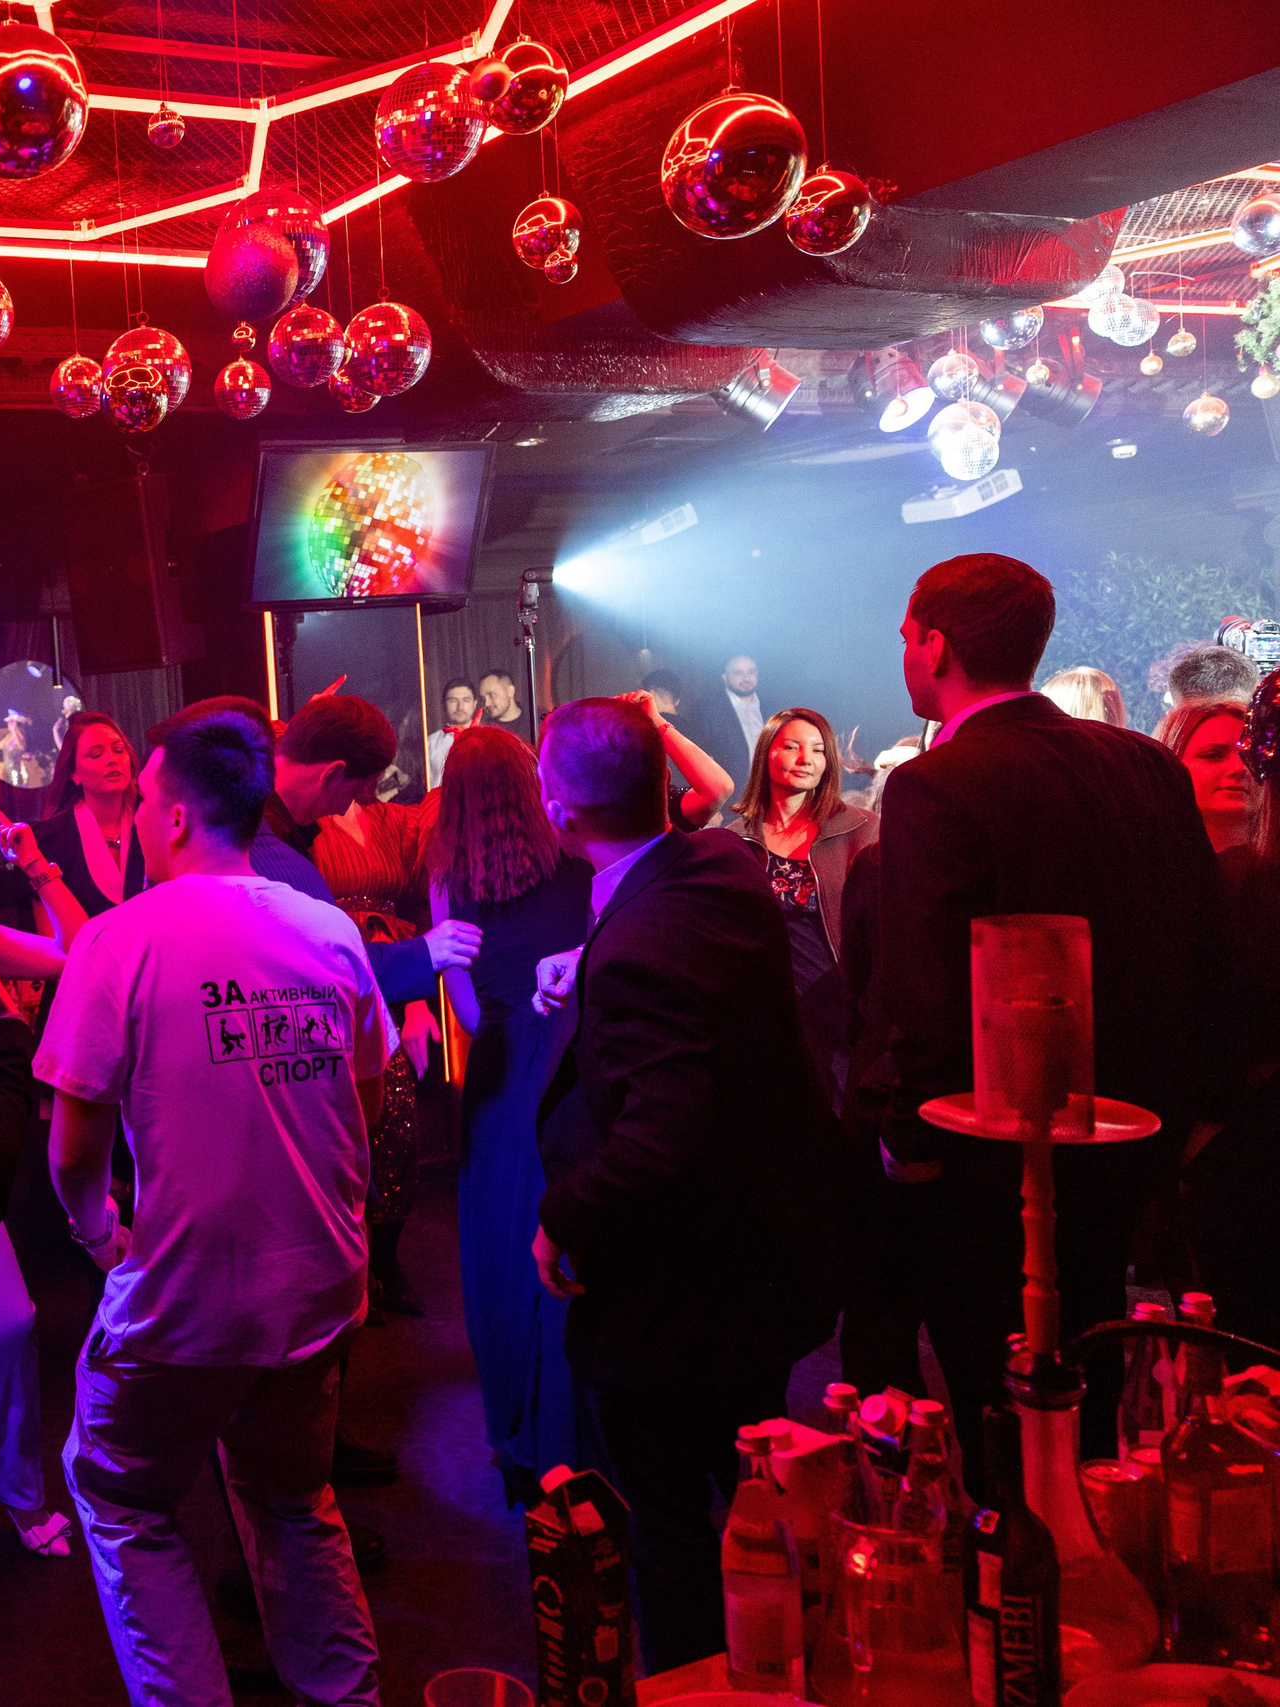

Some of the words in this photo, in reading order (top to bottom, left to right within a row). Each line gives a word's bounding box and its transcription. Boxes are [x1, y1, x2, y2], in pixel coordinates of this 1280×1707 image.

[201, 980, 247, 1008] ЗА
[251, 983, 337, 1004] АКТИВНЫЙ
[260, 1056, 343, 1086] СПОРТ
